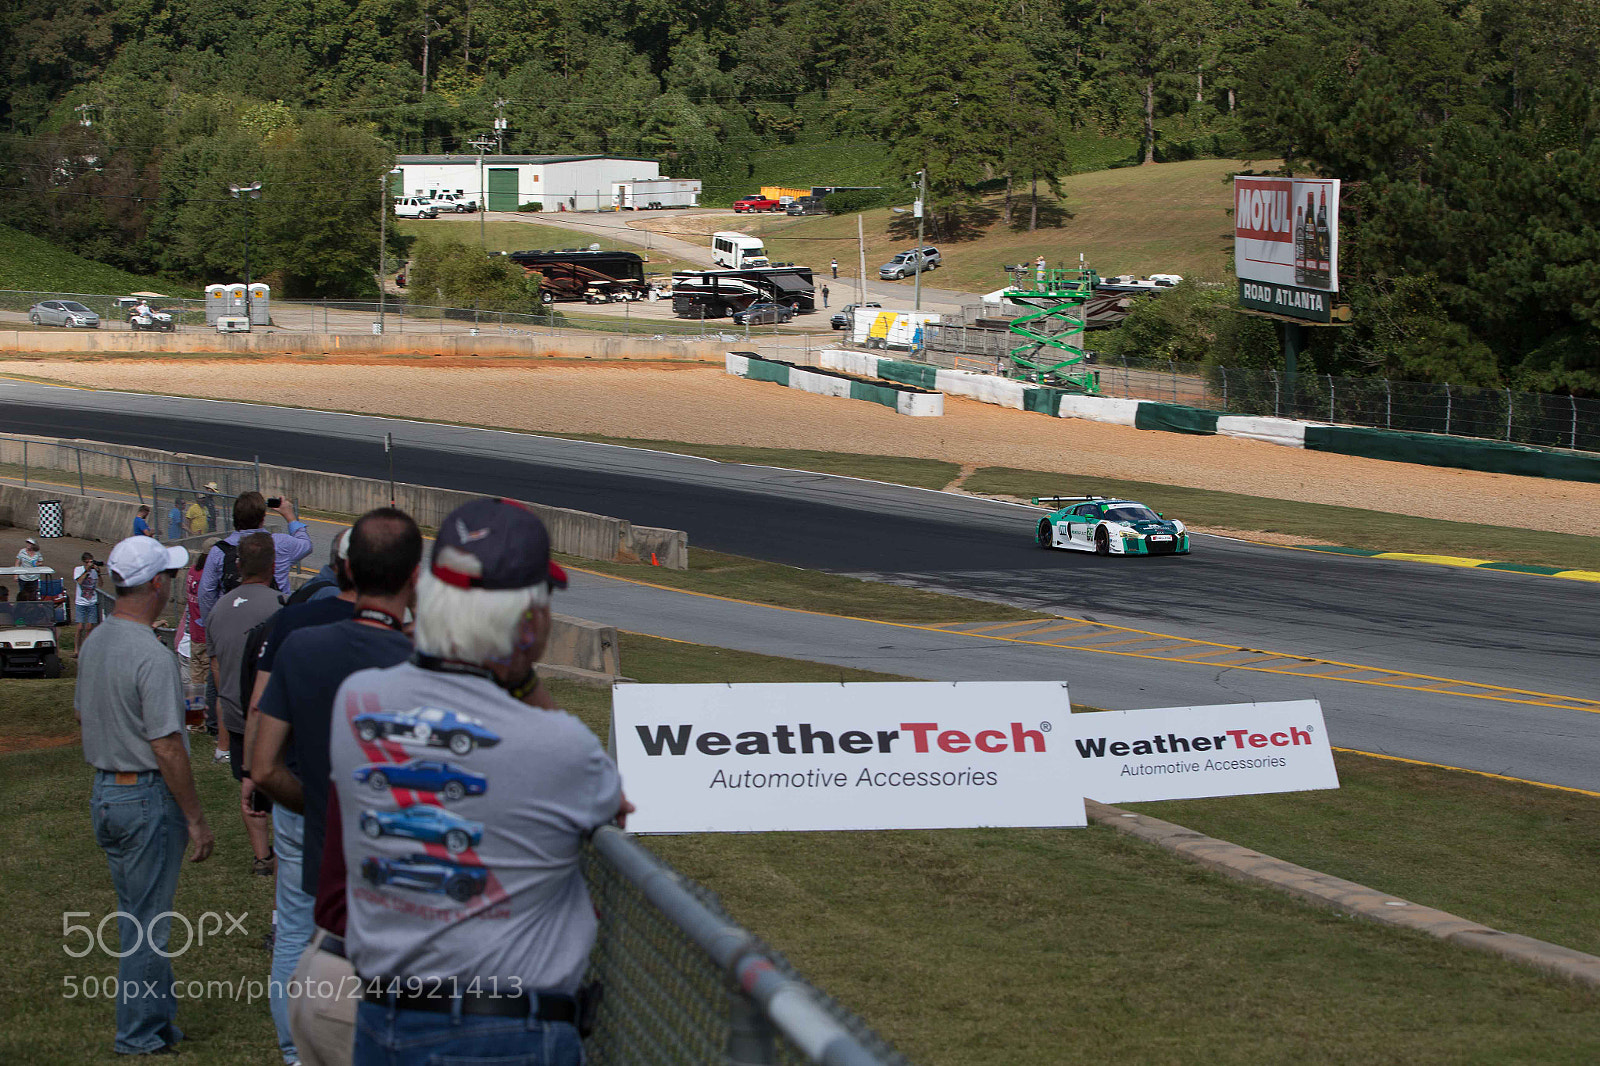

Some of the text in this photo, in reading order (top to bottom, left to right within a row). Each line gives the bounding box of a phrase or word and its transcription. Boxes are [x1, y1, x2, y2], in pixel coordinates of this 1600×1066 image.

[1236, 189, 1290, 233] MOTUL
[1243, 283, 1324, 312] ROAD ATLANTA
[709, 766, 998, 789] Automotive Accessories
[1120, 755, 1286, 777] Automotive Accessories
